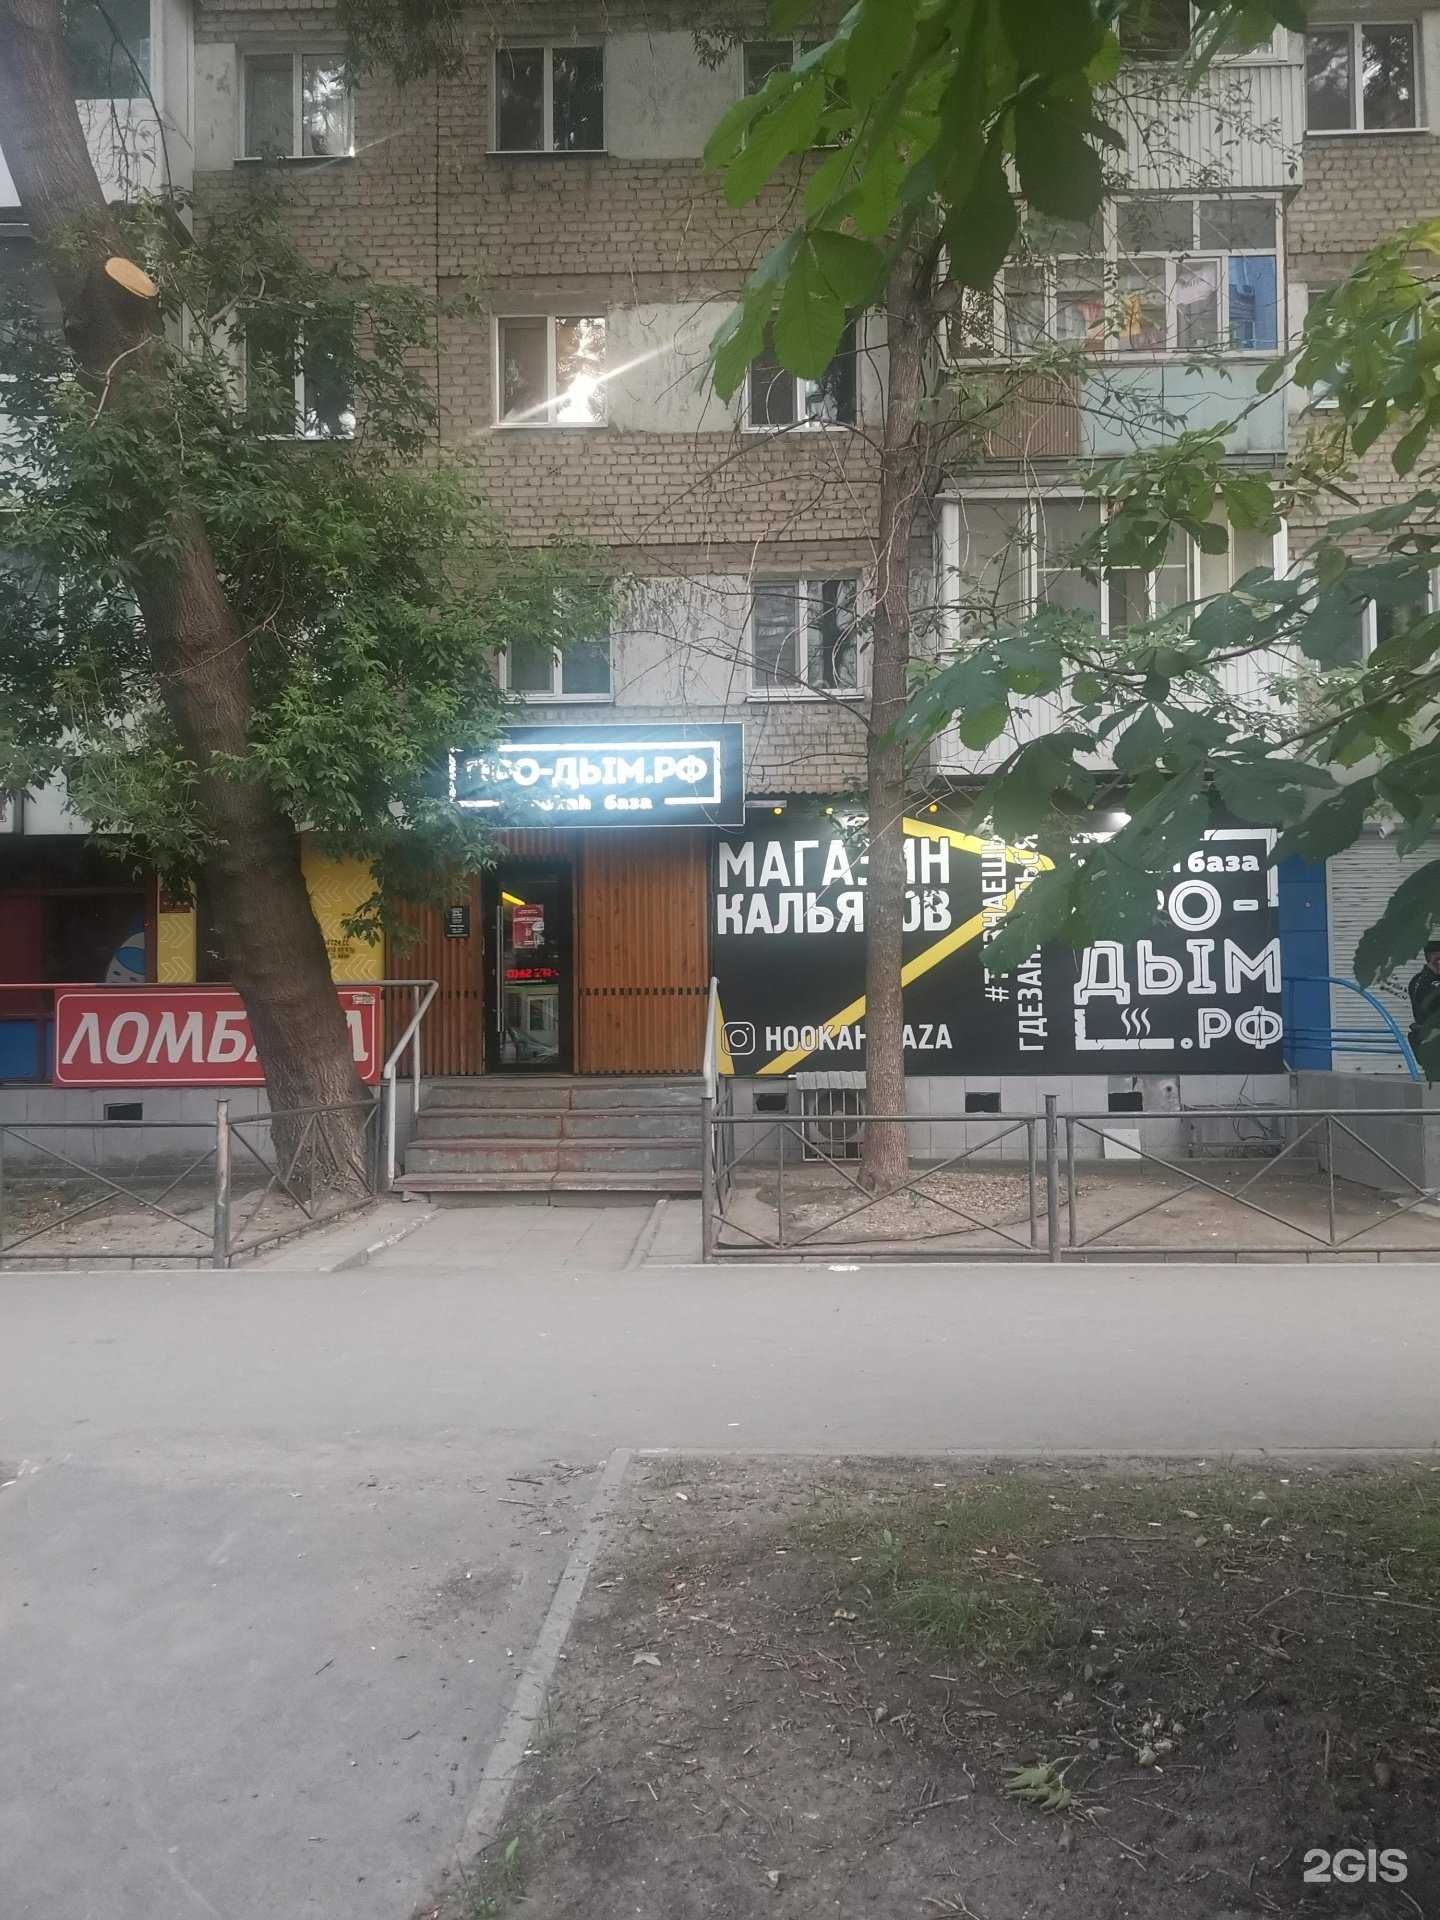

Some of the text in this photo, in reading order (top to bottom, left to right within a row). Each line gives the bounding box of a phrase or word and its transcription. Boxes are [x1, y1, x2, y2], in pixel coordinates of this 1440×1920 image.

[604, 795, 653, 810] база
[1187, 851, 1260, 873] база
[716, 889, 952, 935] КАЛЬЯОВ
[1073, 937, 1283, 1006] ДЫМ
[765, 1023, 953, 1051] HOOKAHAZA
[1180, 1005, 1284, 1050] .РФ
